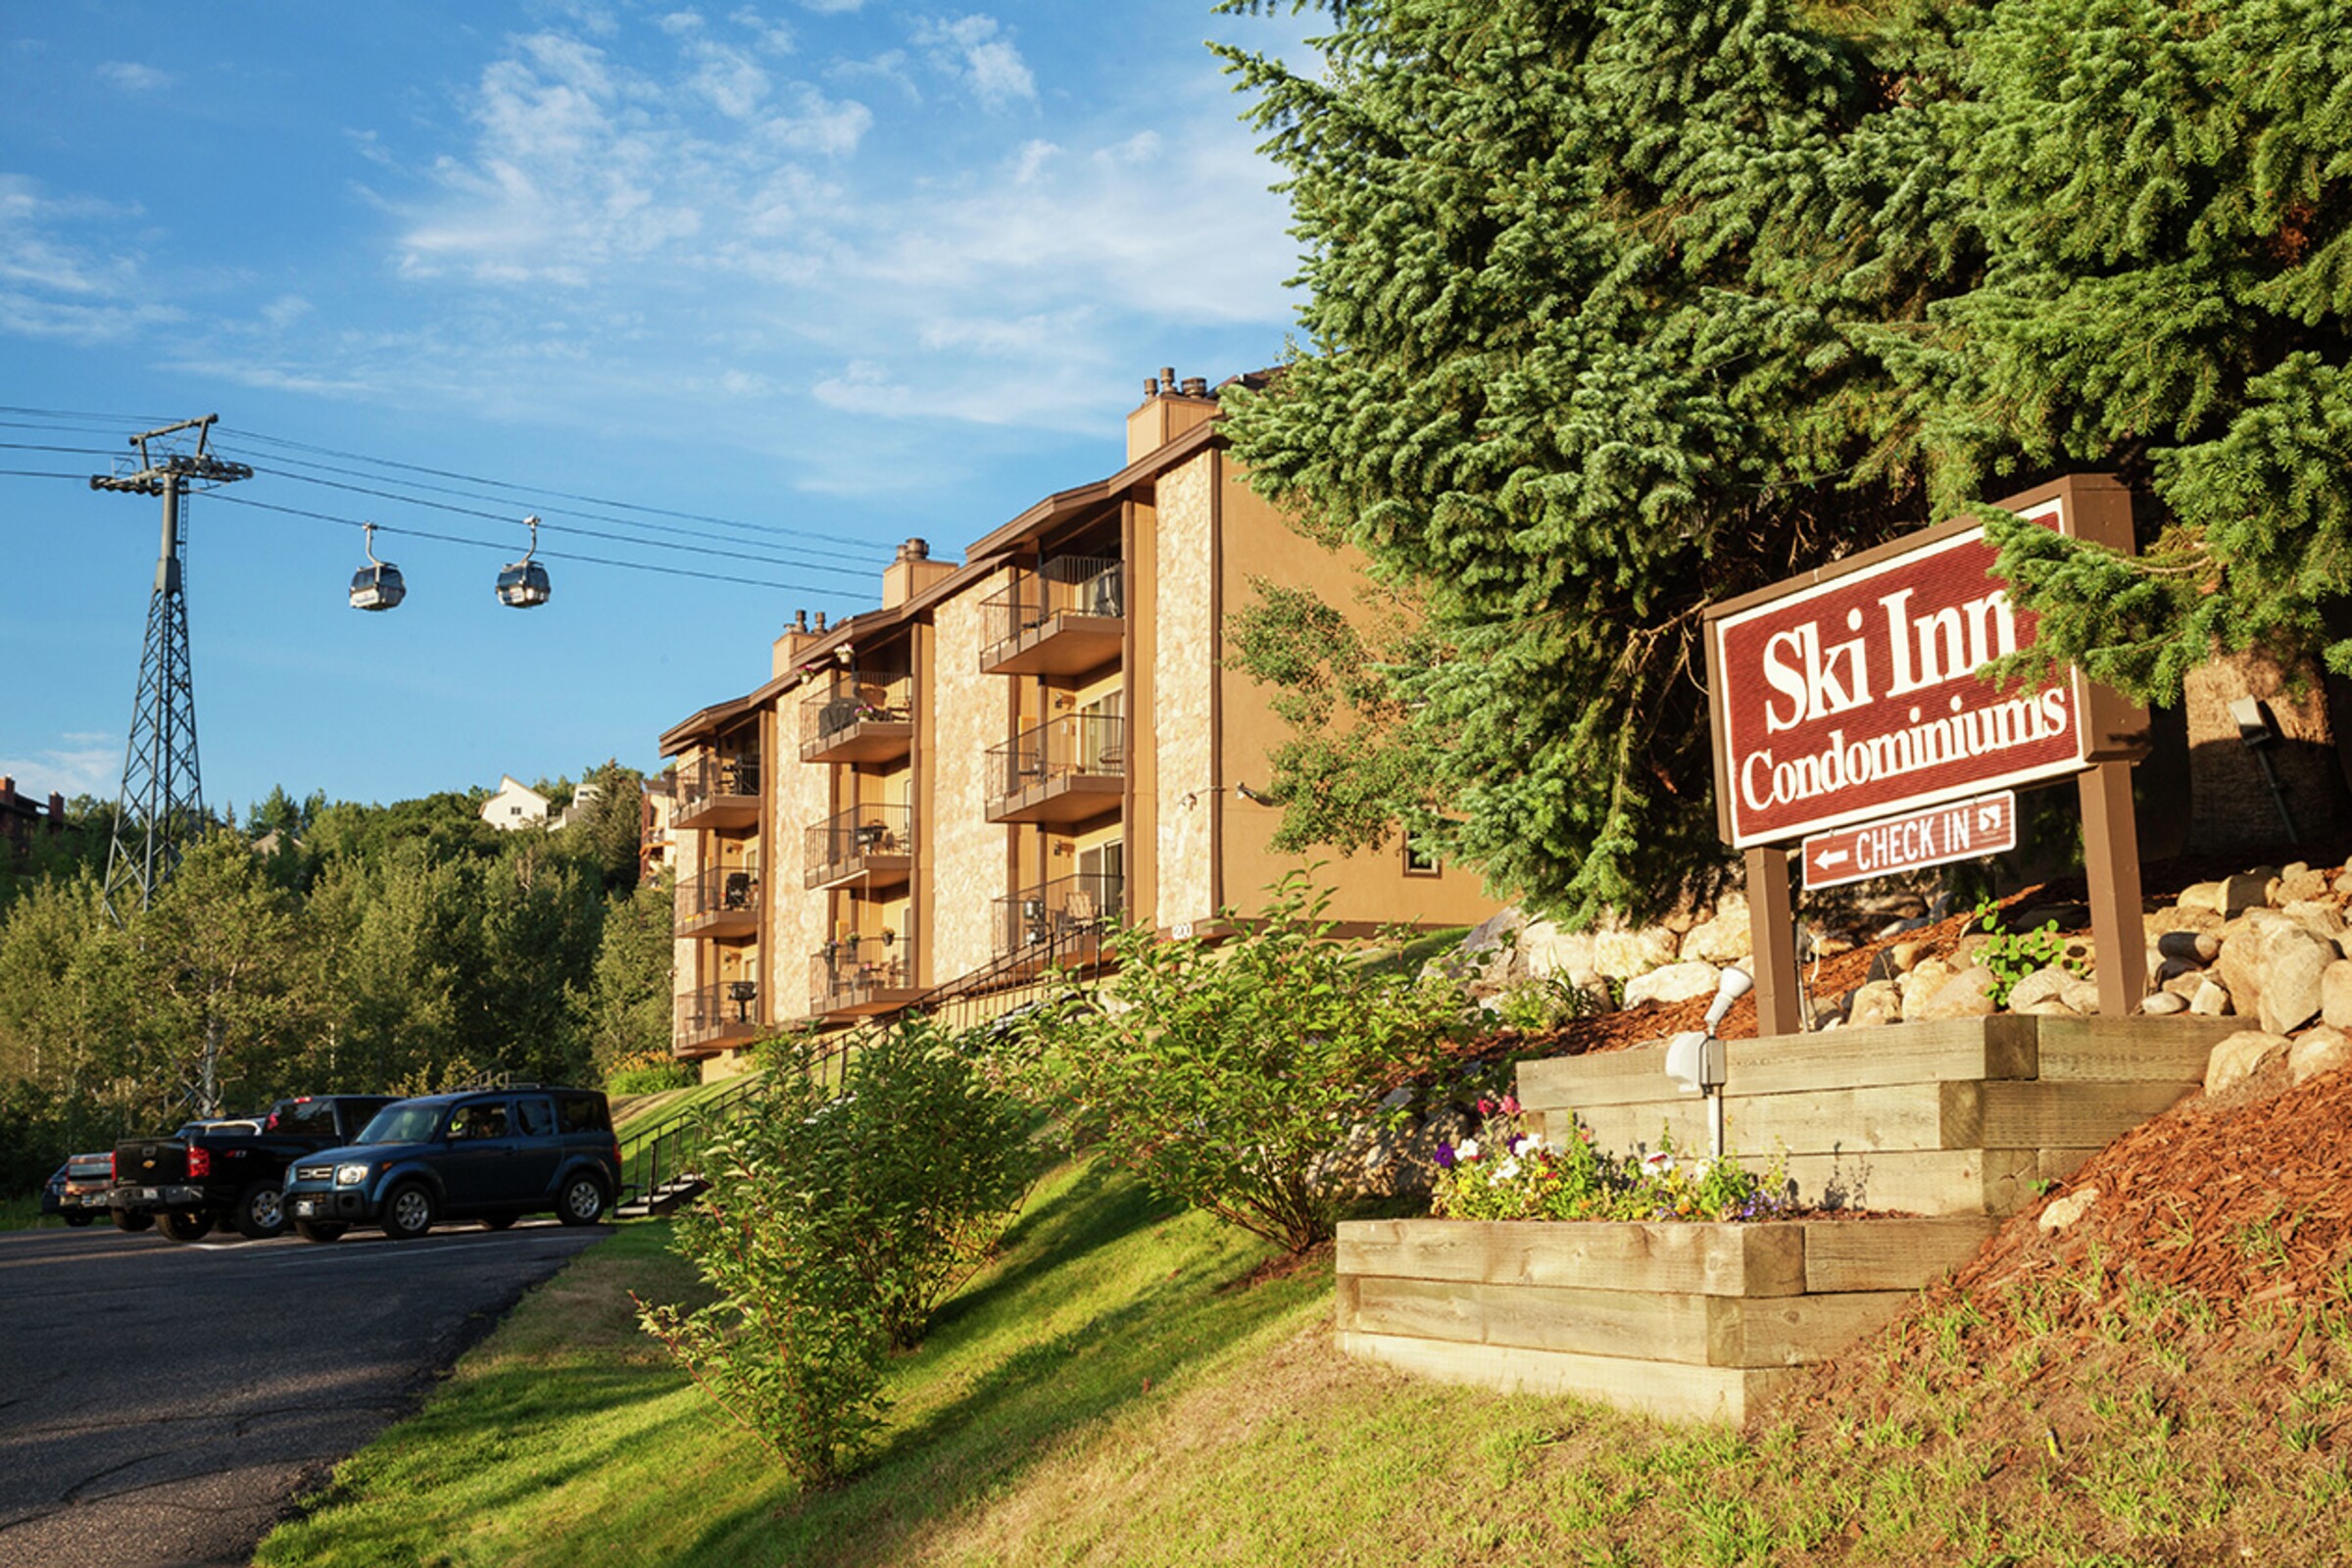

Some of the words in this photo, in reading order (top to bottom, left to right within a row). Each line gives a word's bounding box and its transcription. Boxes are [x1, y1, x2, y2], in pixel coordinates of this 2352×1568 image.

[1763, 608, 1874, 734] Ski
[1880, 588, 2018, 698] Inn
[1740, 687, 2067, 810] Condominiums
[1856, 816, 1935, 870] CHECK
[1943, 808, 1970, 852] IN
